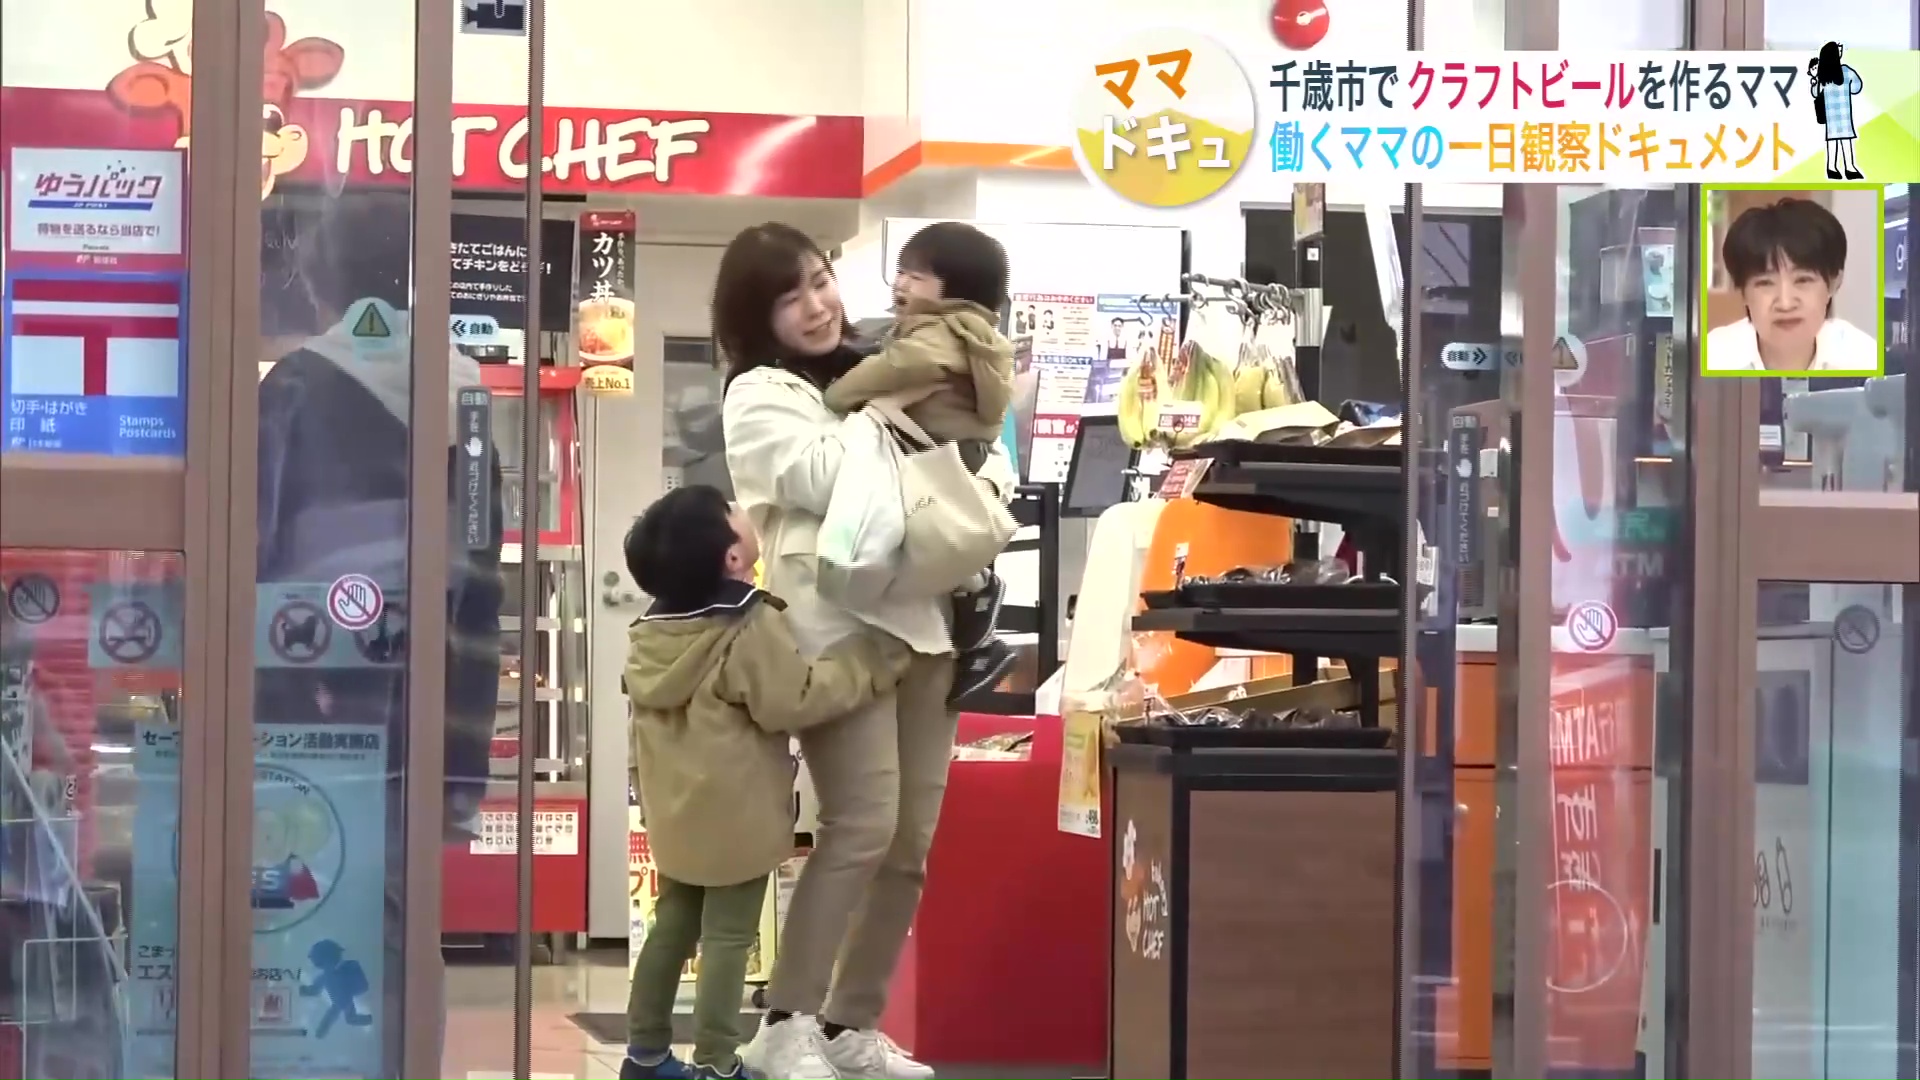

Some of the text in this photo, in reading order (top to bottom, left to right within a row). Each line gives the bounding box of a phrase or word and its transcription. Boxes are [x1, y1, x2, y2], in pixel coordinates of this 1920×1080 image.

[497, 114, 710, 182] CHEF
[34, 171, 163, 199] ゆうパック
[590, 231, 616, 304] カツ丼
[469, 322, 494, 335] 自動
[461, 392, 488, 406] 自動
[118, 414, 165, 429] Stamps
[1452, 415, 1477, 429] 自動
[118, 427, 177, 440] Postcards
